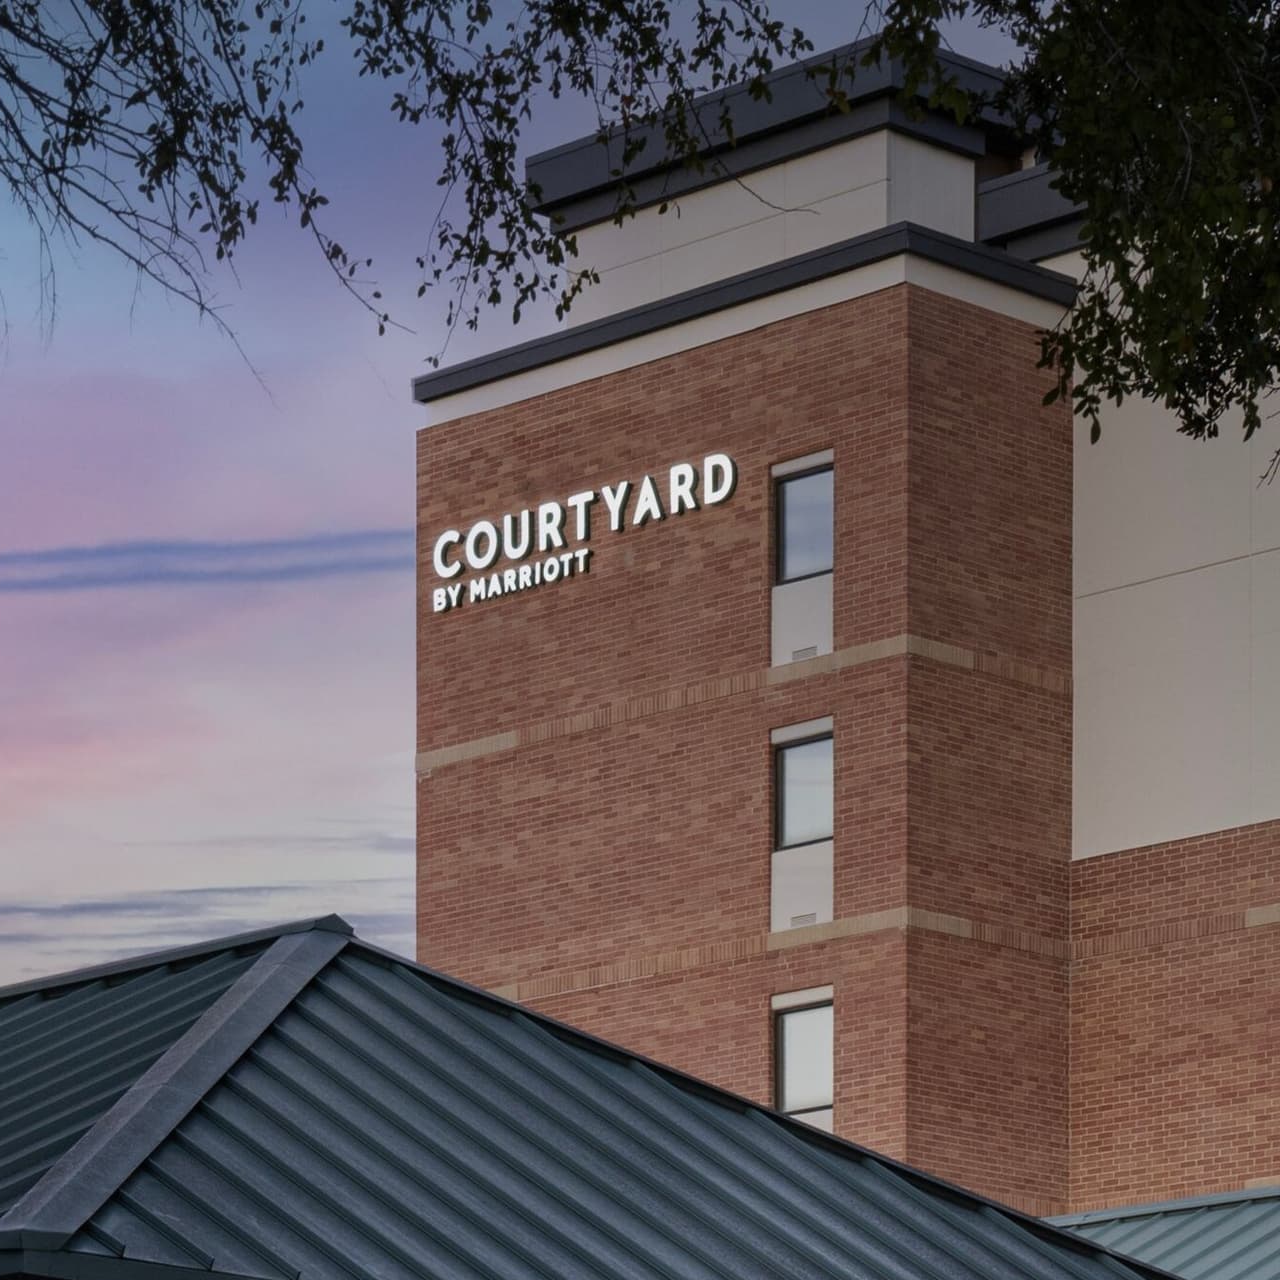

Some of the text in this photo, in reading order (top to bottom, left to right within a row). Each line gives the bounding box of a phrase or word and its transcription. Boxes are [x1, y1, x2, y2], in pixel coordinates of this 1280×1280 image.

[432, 453, 734, 579] COURTYARD
[432, 547, 589, 613] BY MARRIOTT
